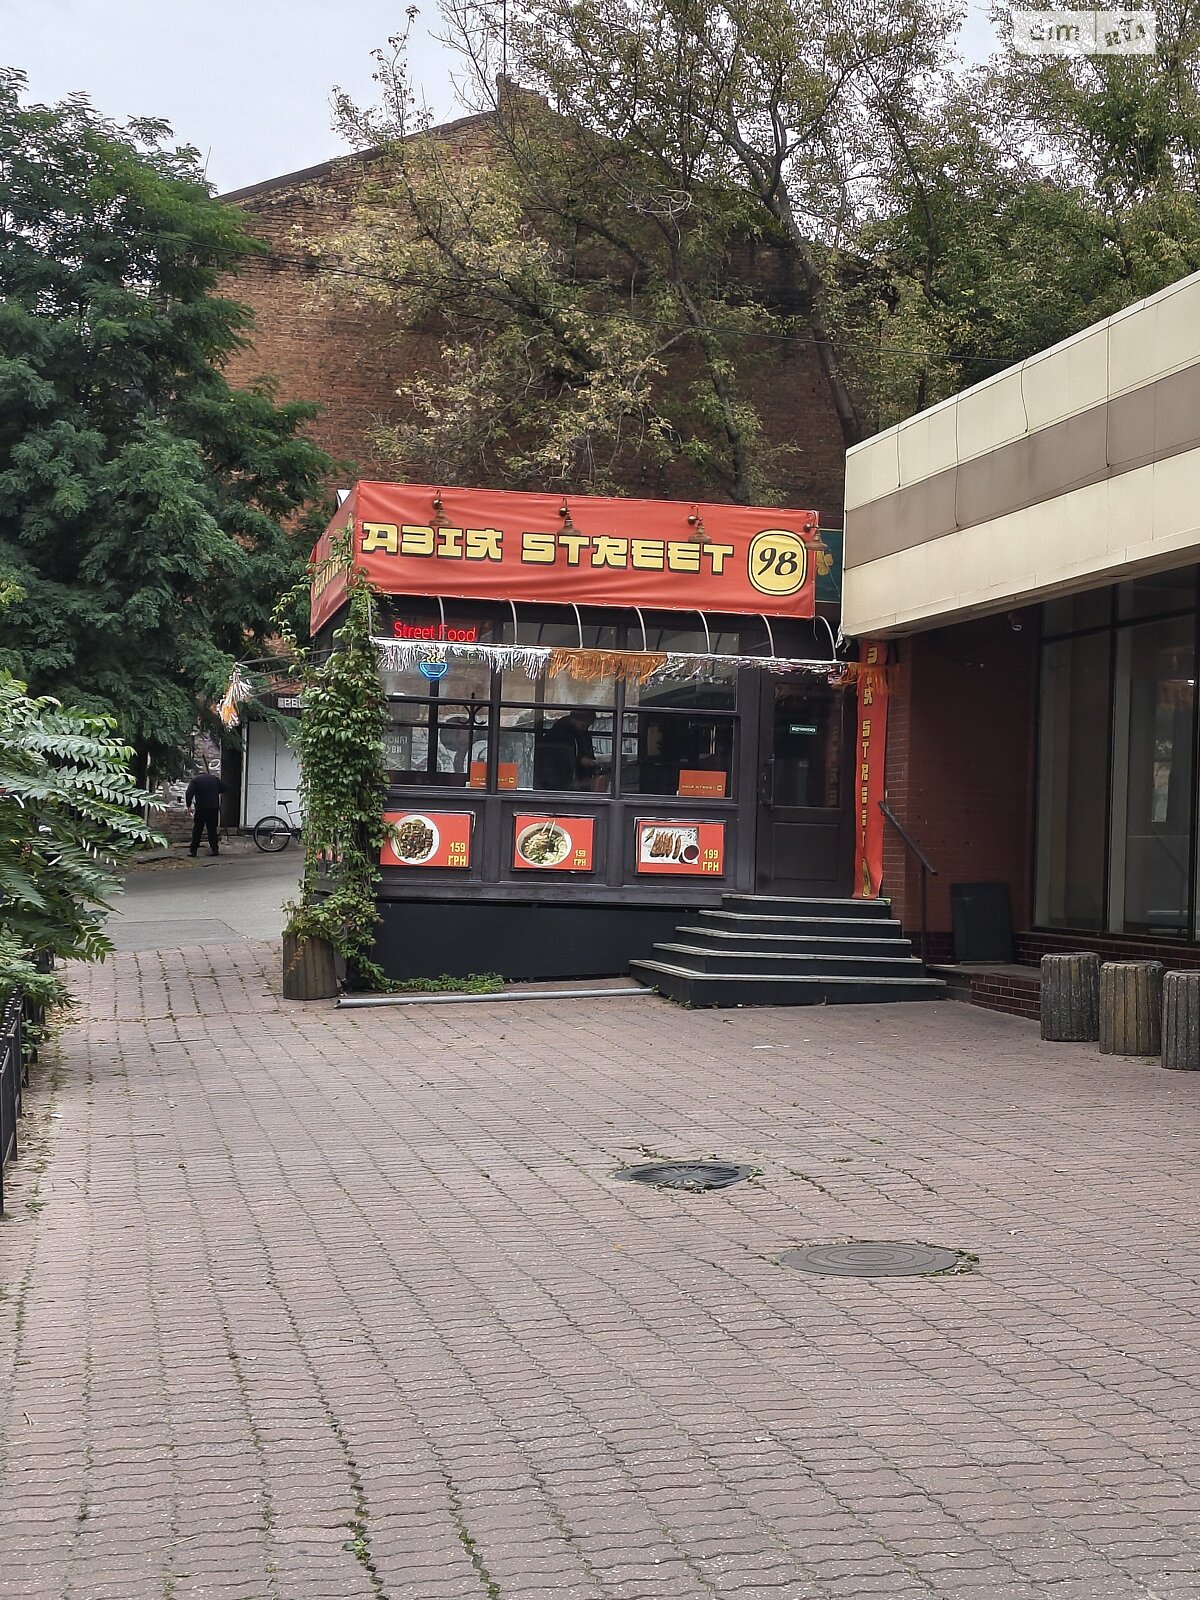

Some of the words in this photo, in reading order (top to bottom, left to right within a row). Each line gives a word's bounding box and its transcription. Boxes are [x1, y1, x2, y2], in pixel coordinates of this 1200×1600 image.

[521, 532, 735, 575] STREET
[756, 547, 799, 577] 98
[393, 621, 437, 640] Street
[439, 623, 478, 642] Food
[449, 842, 466, 853] 159
[703, 849, 719, 859] 199
[448, 855, 467, 867] ГРН
[702, 861, 719, 871] ГРН
